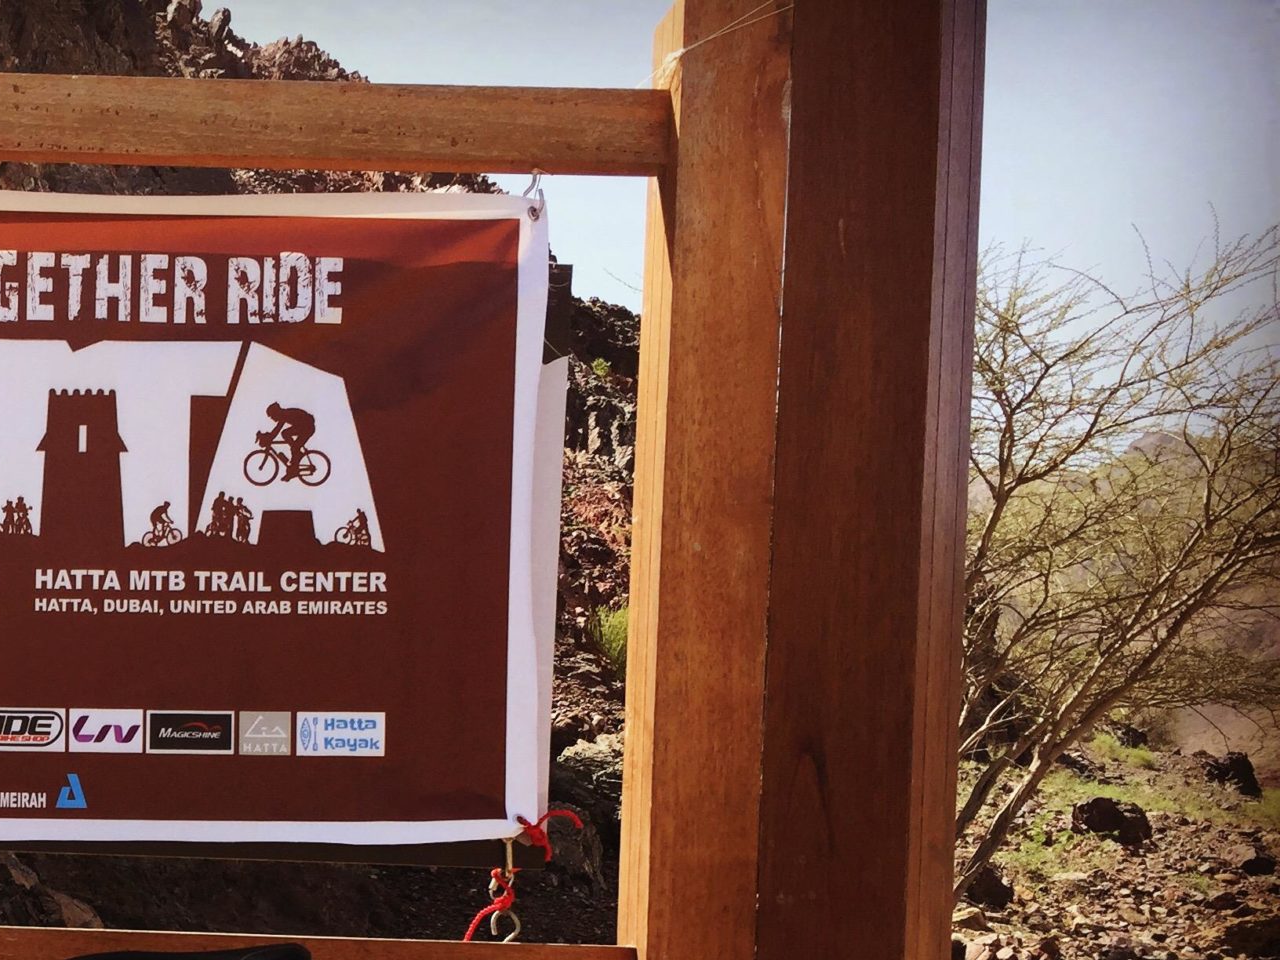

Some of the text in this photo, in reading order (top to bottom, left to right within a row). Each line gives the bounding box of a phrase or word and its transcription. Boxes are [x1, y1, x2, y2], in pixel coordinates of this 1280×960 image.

[226, 252, 344, 325] RIDE
[35, 568, 388, 594] HATTA MTB TRAIL CENTER
[34, 598, 388, 616] HATTA, DUBAI, UNITED ARAB EMIRATES
[324, 717, 377, 732] Hatta
[243, 744, 288, 753] HATTA
[324, 736, 380, 751] Kayak
